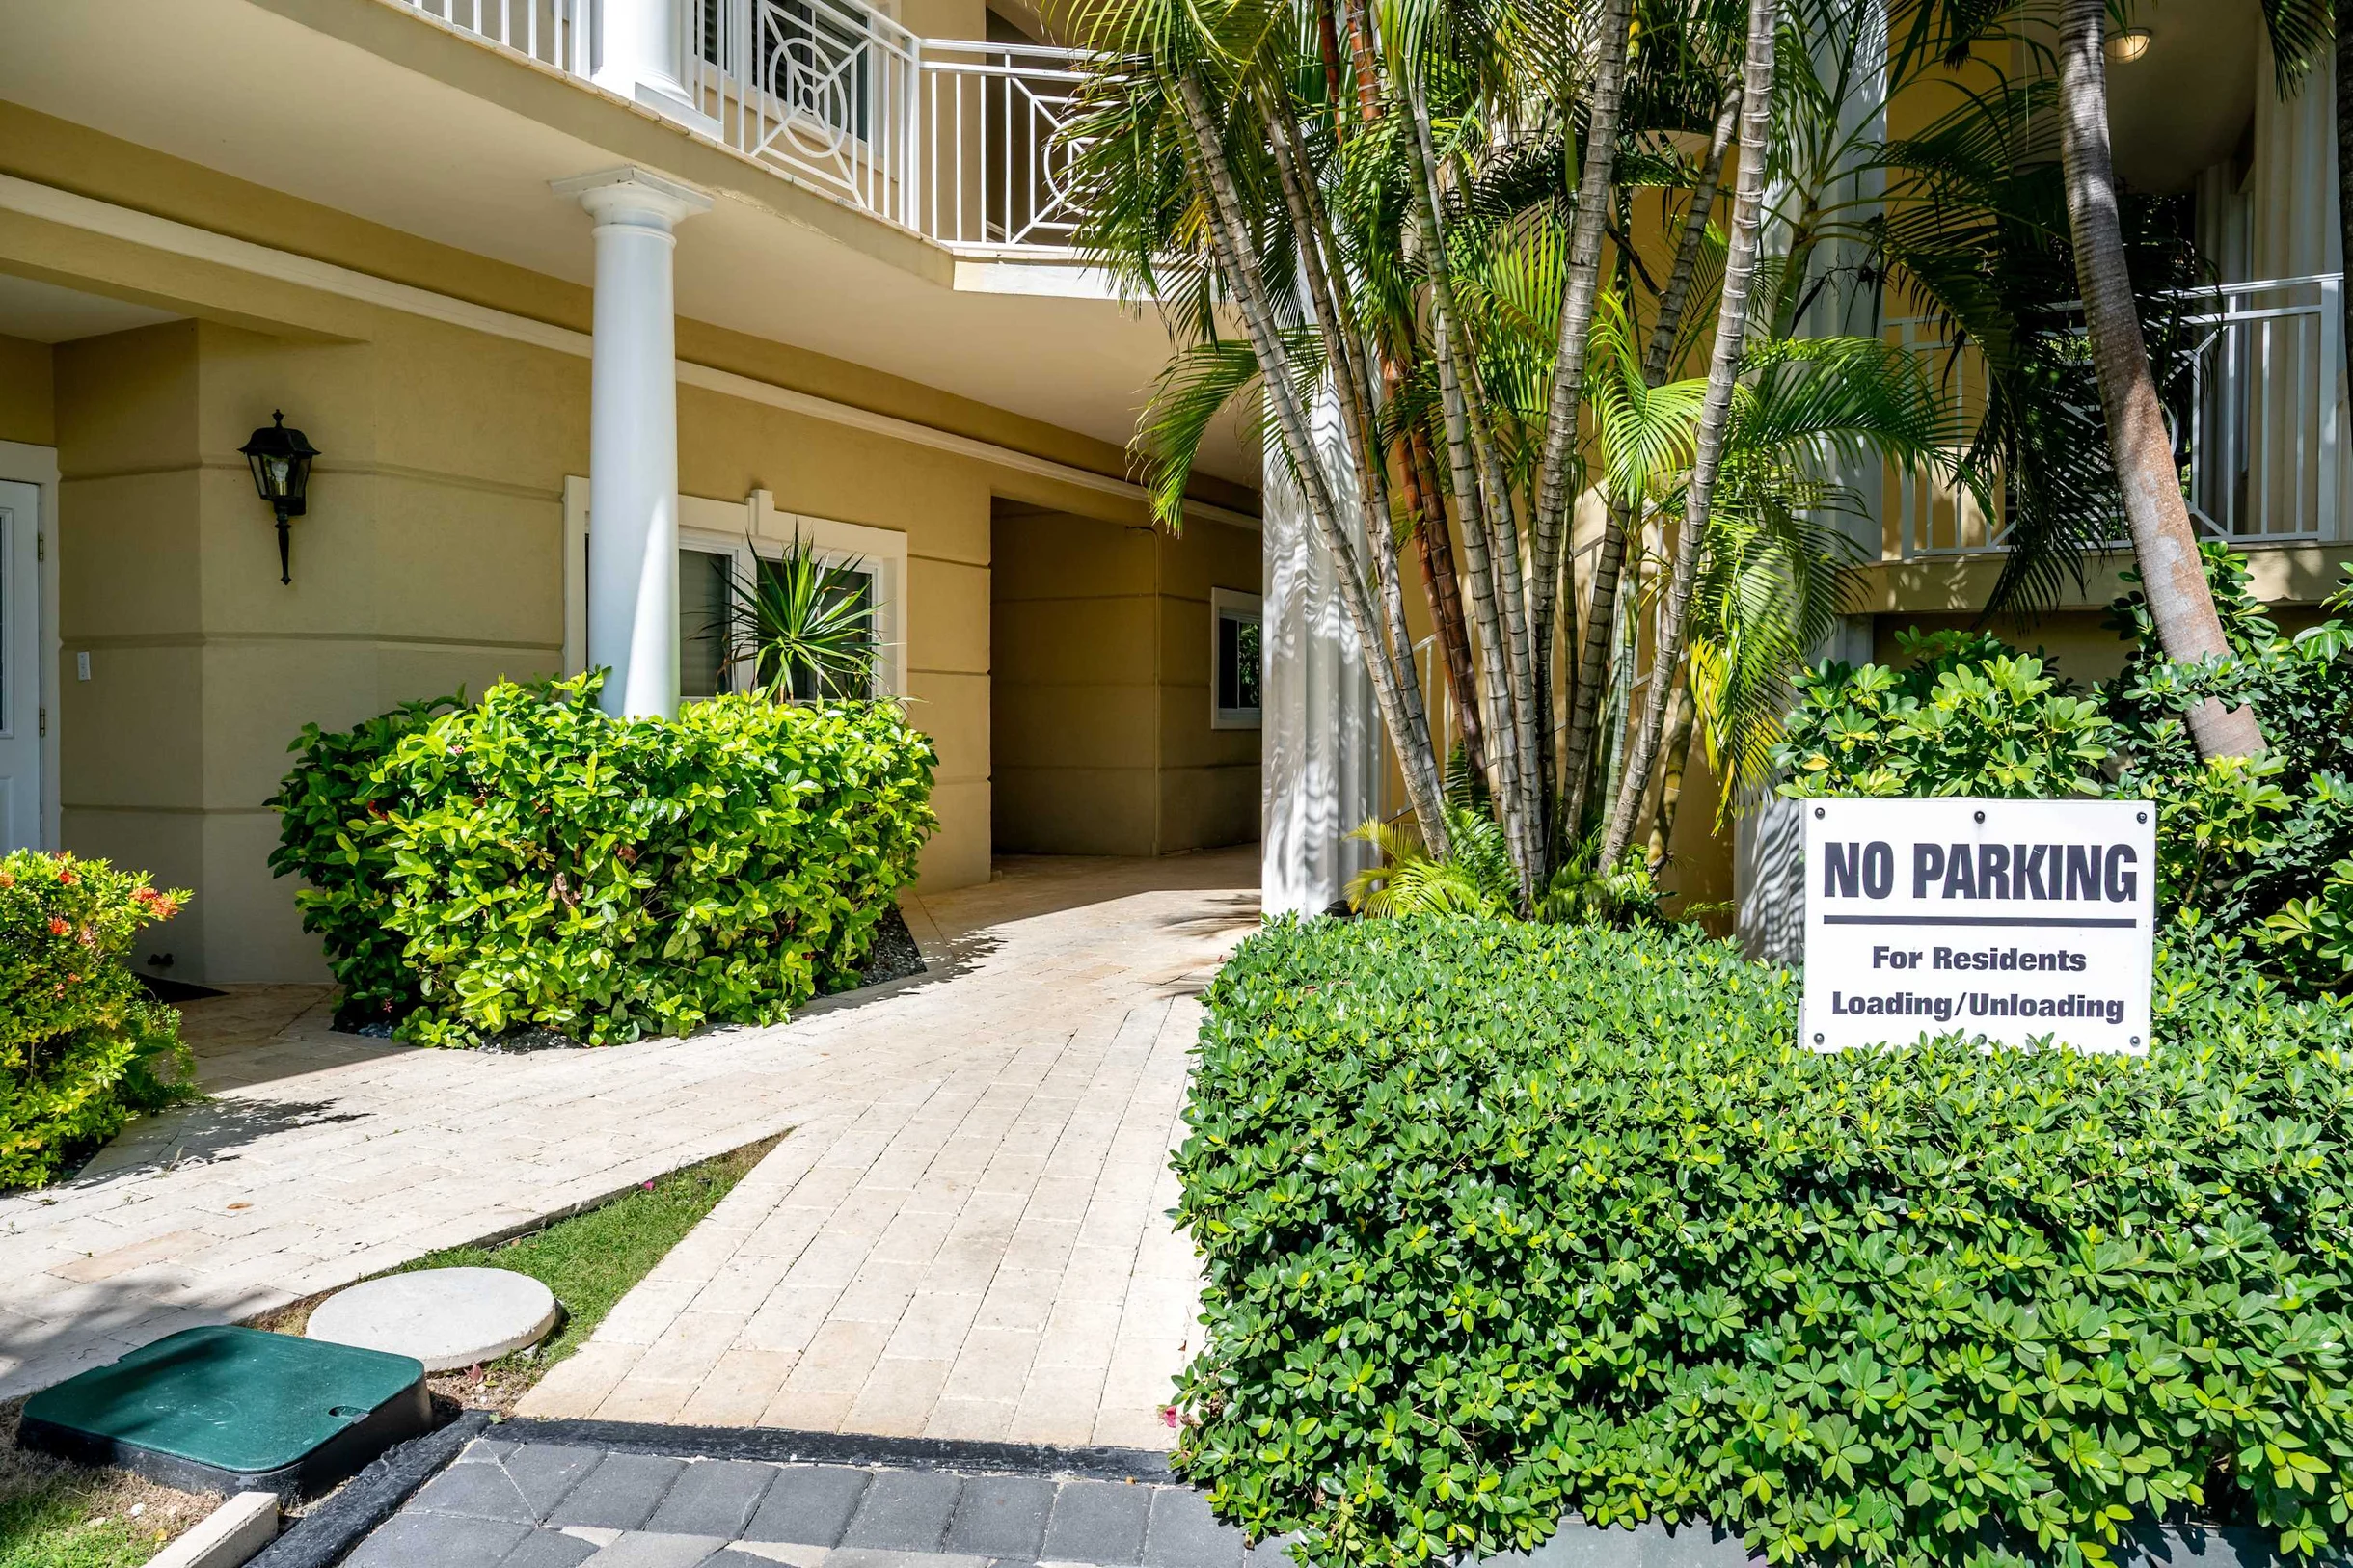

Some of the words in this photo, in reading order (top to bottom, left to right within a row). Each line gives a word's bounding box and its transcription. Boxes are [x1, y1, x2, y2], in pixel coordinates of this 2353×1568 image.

[1824, 841, 1894, 899] NO
[1912, 843, 2138, 903] PARKING
[1873, 946, 1923, 969] For
[1933, 947, 2087, 971] Residents
[1832, 991, 2124, 1024] Loading/Unloading
